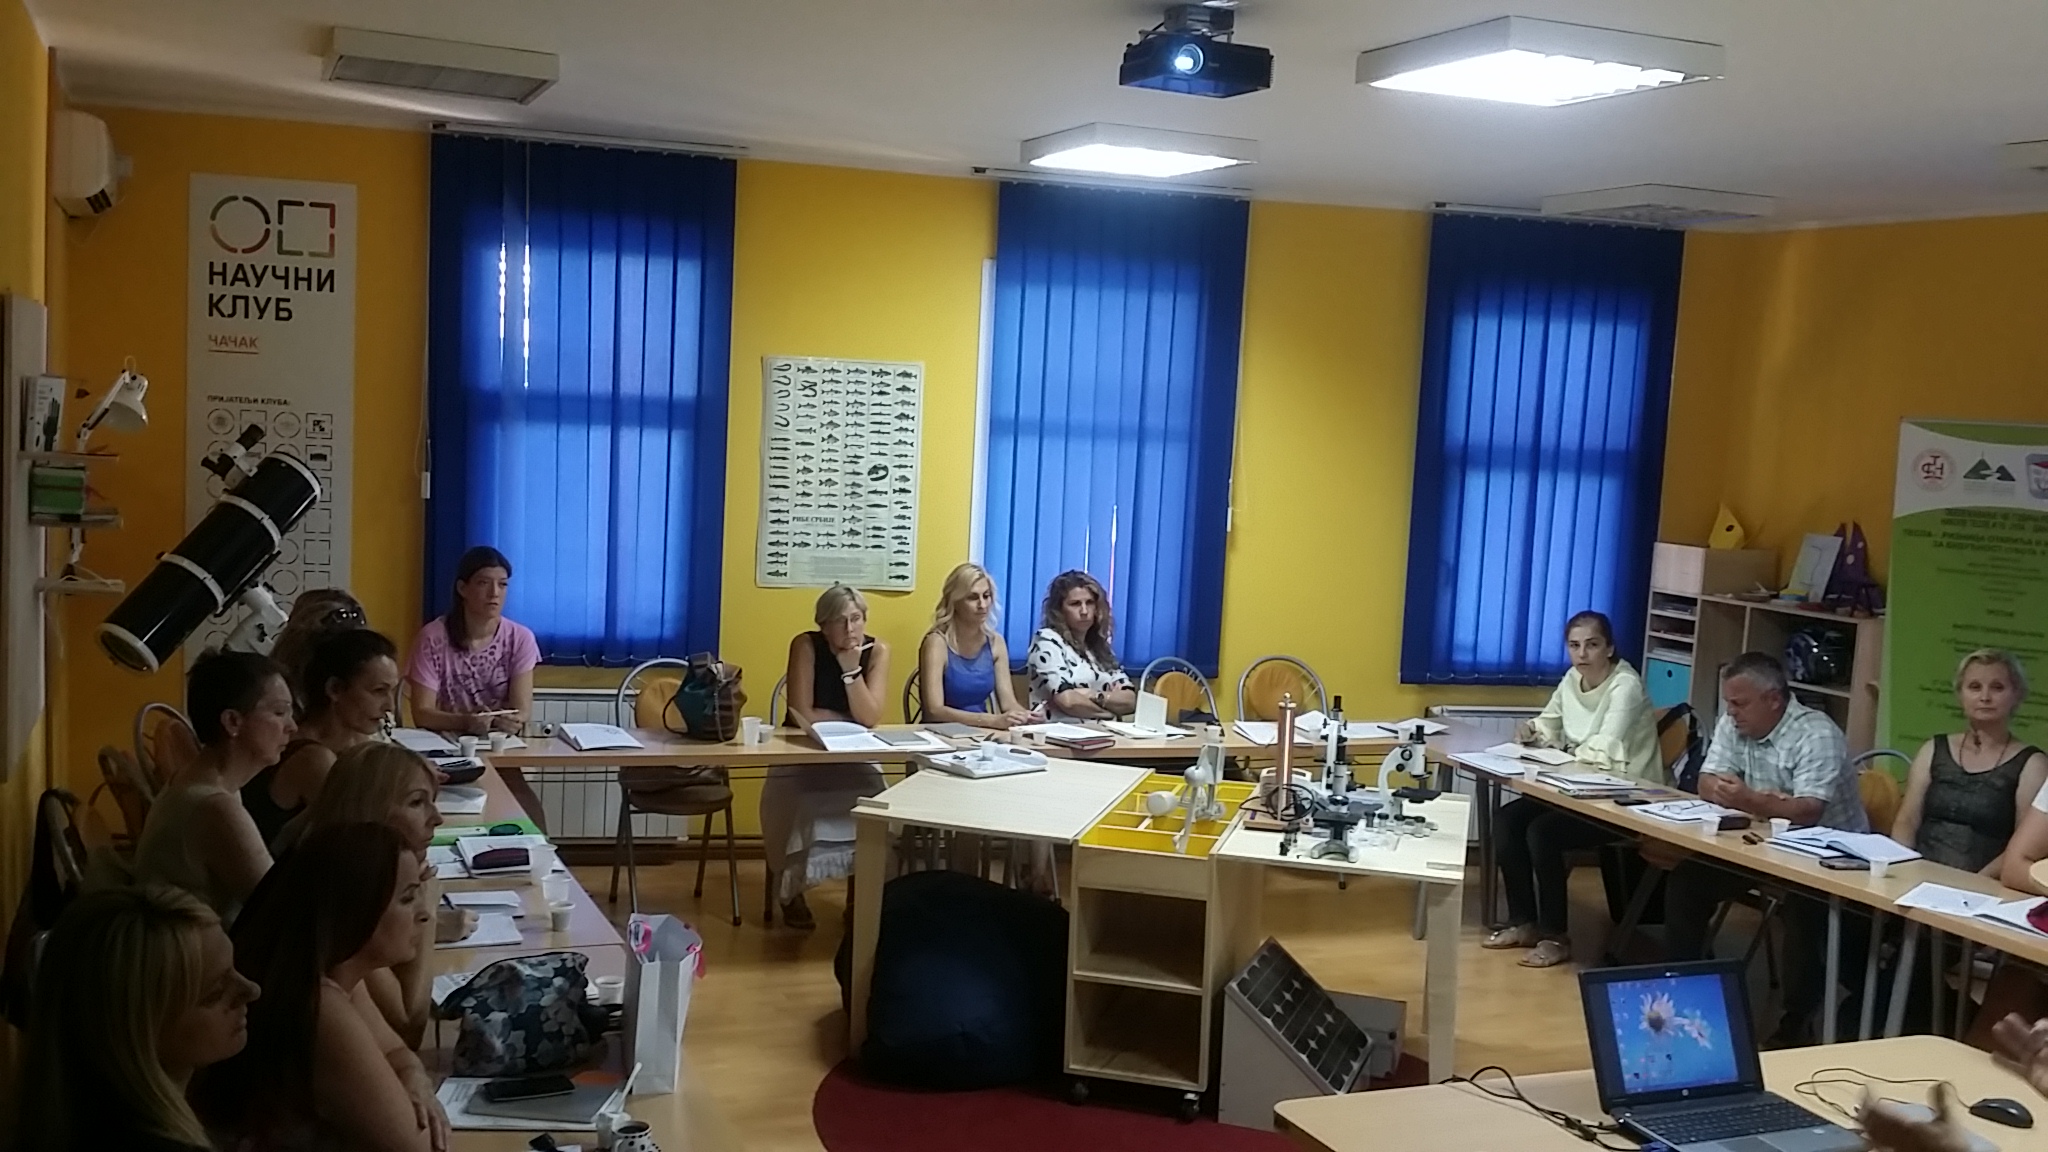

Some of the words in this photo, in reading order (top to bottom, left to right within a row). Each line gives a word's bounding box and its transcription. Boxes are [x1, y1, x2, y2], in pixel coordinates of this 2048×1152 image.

[208, 261, 335, 293] НАУЧНИ
[208, 293, 293, 321] КЛУБ
[208, 334, 259, 348] ЧАЧАК
